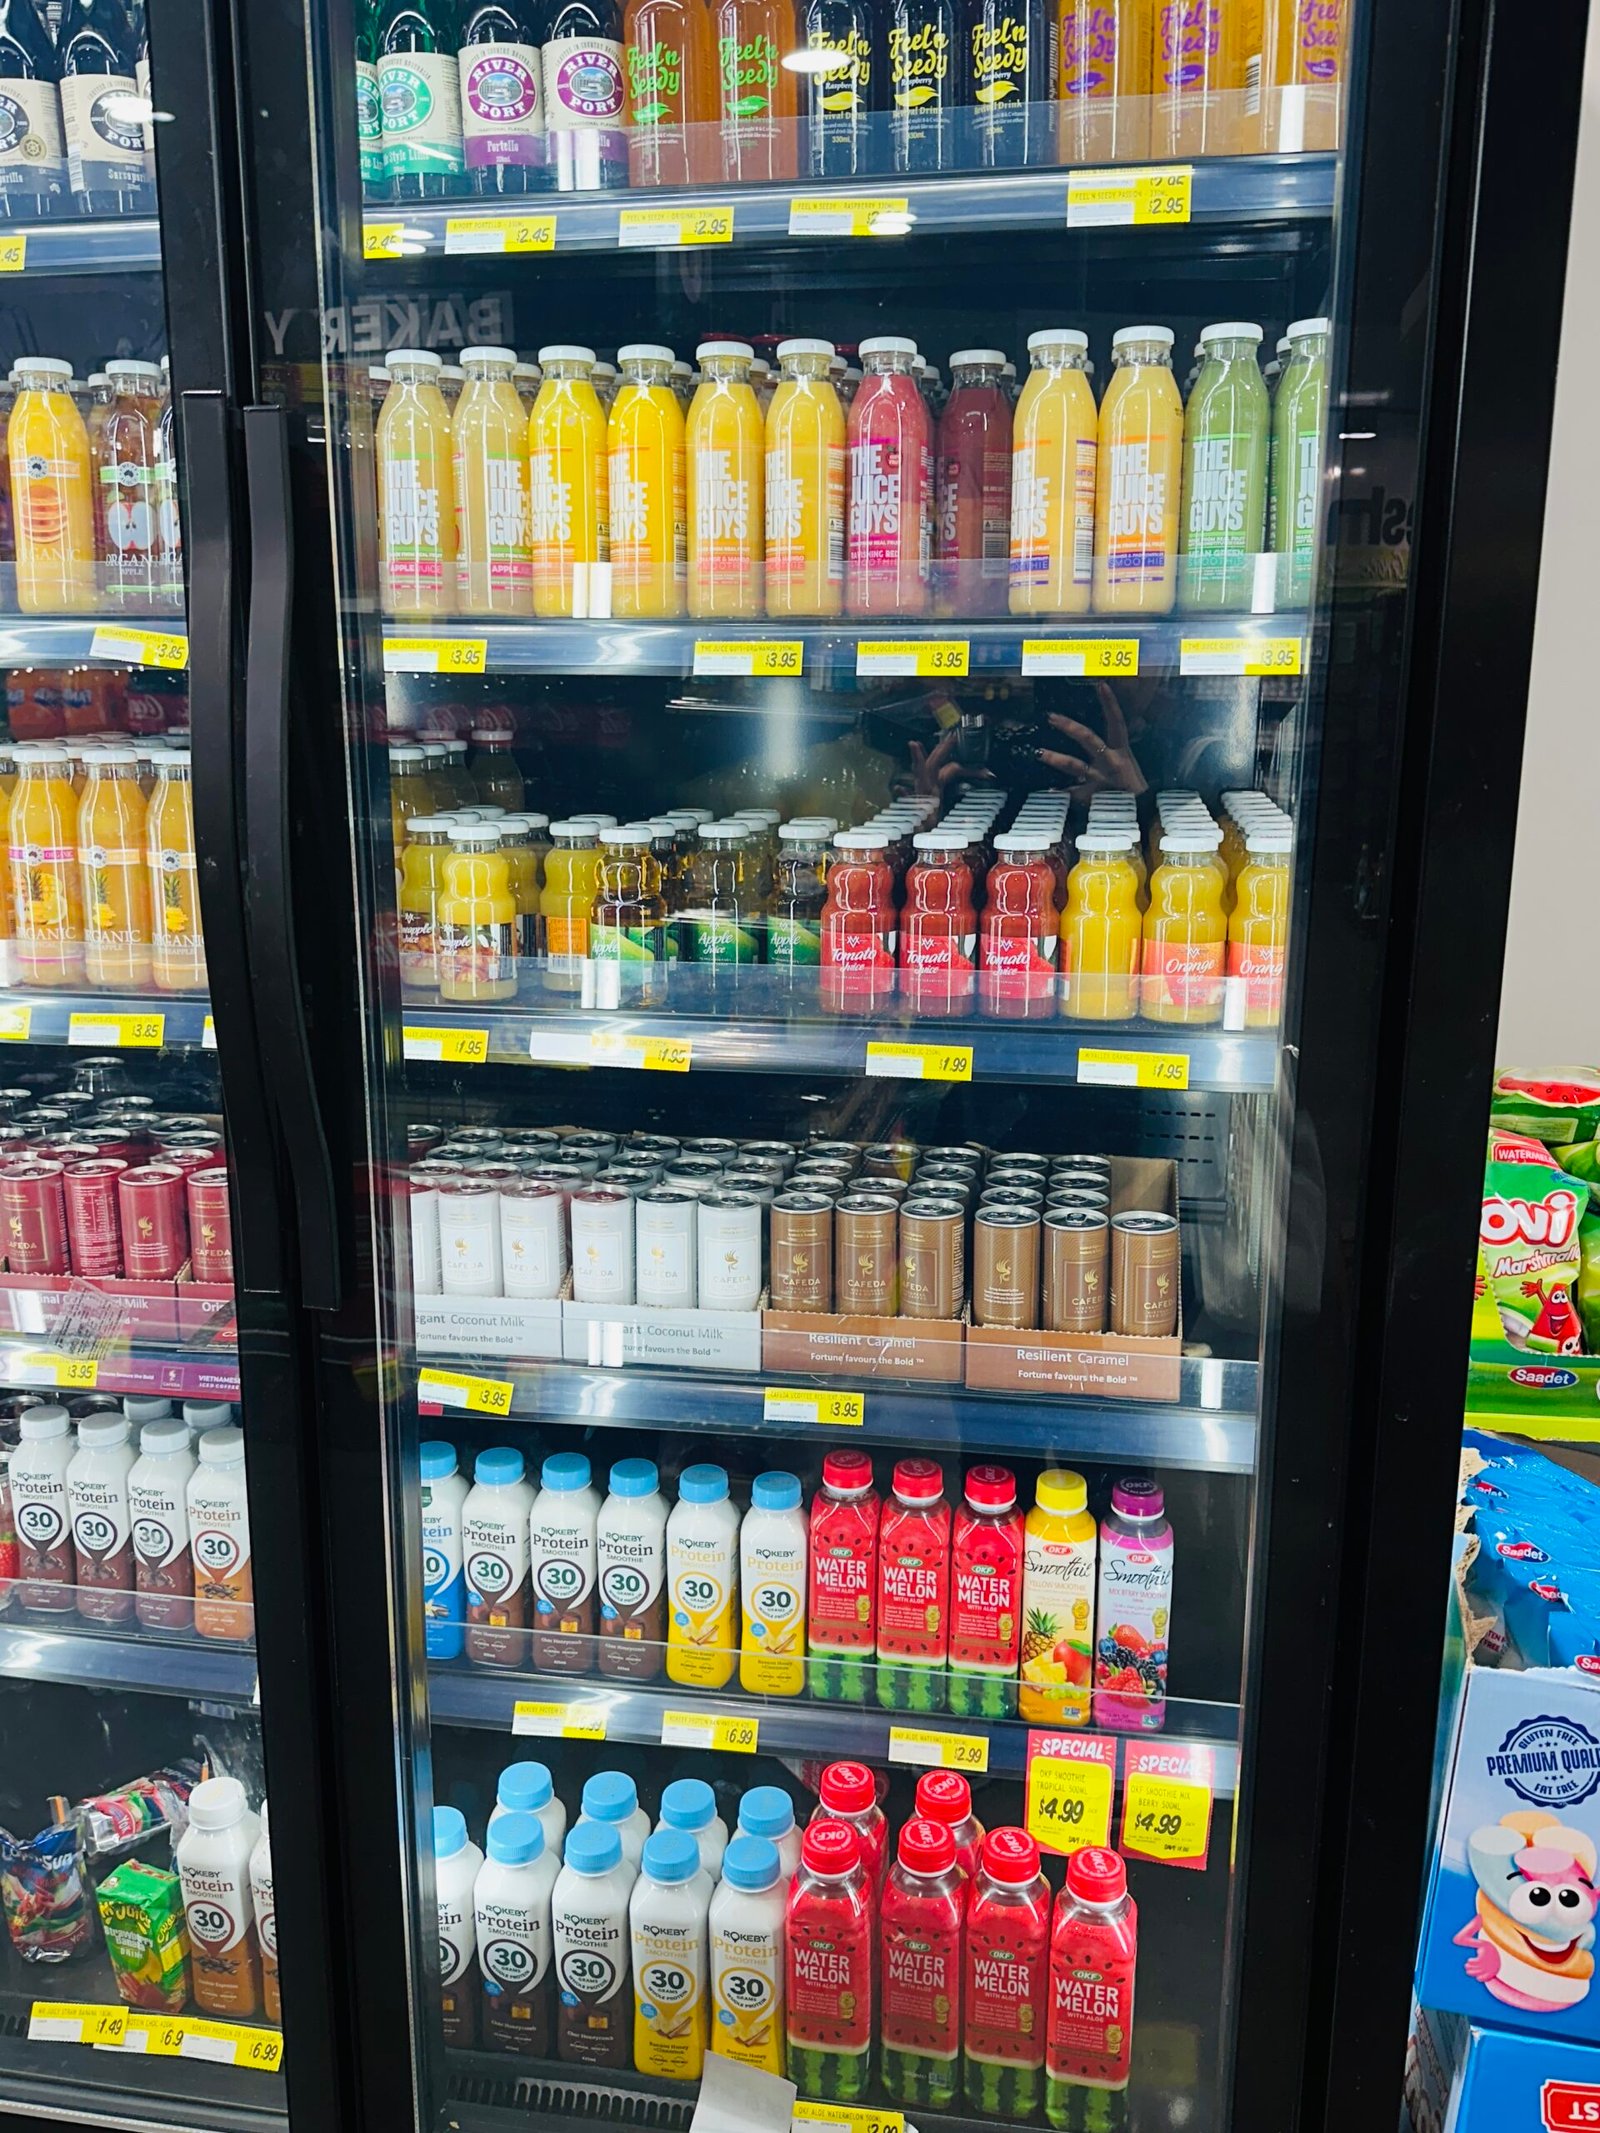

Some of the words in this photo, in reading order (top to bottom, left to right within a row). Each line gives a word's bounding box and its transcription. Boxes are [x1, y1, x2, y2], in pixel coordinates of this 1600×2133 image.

[889, 23, 949, 59] Feel'n
[972, 17, 1028, 49] Feel'n
[472, 58, 527, 81] RIVER
[564, 52, 618, 77] RIVER
[892, 52, 949, 83] Seedy
[973, 44, 1028, 79] Seedy
[630, 66, 680, 99] Seedy
[723, 60, 778, 91] Seedy
[981, 71, 1012, 82] Raspberry
[478, 101, 526, 119] PORT
[569, 96, 617, 116] PORT
[487, 139, 519, 153] Portello
[1148, 198, 1184, 214] $2.95
[694, 219, 728, 235] $2.95
[850, 443, 883, 476] THE
[1193, 440, 1230, 471] THE
[850, 474, 899, 505] JUICE
[1191, 469, 1248, 502] JUICE
[850, 503, 899, 536] GUYS
[1190, 500, 1244, 533] GUYS
[389, 517, 438, 545] GUYS
[766, 652, 797, 668] $3.95
[931, 653, 963, 668] $3.95
[1100, 651, 1132, 667] $3.95
[698, 931, 734, 946] Apple
[770, 932, 800, 946] Apple
[832, 947, 876, 963] Tomato
[907, 949, 951, 965] Tomato
[986, 951, 1030, 966] Tomato
[1166, 958, 1216, 975] Orange
[1240, 959, 1284, 976] Orang
[455, 1040, 482, 1055] $1.95
[939, 1057, 967, 1072] $1.99
[1153, 1063, 1184, 1080] $1.95
[783, 1278, 821, 1286] CAFEDA
[848, 1279, 886, 1288] CAFEDA
[124, 1298, 149, 1310] Milk
[450, 1314, 497, 1326] Coconut
[500, 1316, 525, 1327] Milk
[416, 1332, 447, 1341] Fortune
[448, 1333, 478, 1343] favours
[480, 1335, 493, 1343] the
[495, 1335, 513, 1344] Bold
[647, 1325, 694, 1338] Coconut
[698, 1328, 723, 1340] Milk
[809, 1333, 861, 1345] Resilient
[867, 1337, 915, 1349] Caramel
[810, 1352, 843, 1362] Fortune
[845, 1354, 876, 1364] favours
[879, 1356, 893, 1365] the
[895, 1357, 914, 1366] Bold
[1017, 1349, 1072, 1363] Resilient
[1078, 1352, 1129, 1366] Caramel
[1018, 1369, 1053, 1380] Fortune
[1054, 1372, 1088, 1382] favours
[1089, 1374, 1104, 1383] the
[1107, 1375, 1127, 1384] Bold
[1515, 1367, 1570, 1385] Saadet
[480, 1389, 507, 1407] $3.95
[830, 1402, 858, 1418] $3.95
[11, 1479, 64, 1494] Protein
[26, 1511, 53, 1528] 30
[189, 1507, 242, 1522] Protein
[82, 1520, 108, 1537] 30
[469, 1520, 506, 1531] ROKEBY
[203, 1539, 231, 1556] 30
[533, 1534, 589, 1551] Protein
[599, 1538, 653, 1557] Protein
[832, 1548, 851, 1557] OKF
[1501, 1543, 1544, 1561] Saadet
[476, 1560, 504, 1579] 30
[816, 1557, 866, 1574] WATER
[901, 1558, 919, 1566] OKF
[547, 1568, 576, 1586] 30
[612, 1573, 640, 1592] 30
[816, 1572, 867, 1589] MELON
[884, 1566, 937, 1586] WATER
[957, 1574, 1010, 1593] WATER
[884, 1581, 937, 1600] MELON
[957, 1590, 1010, 1607] MELON
[725, 1728, 752, 1744] $6.99
[1517, 1729, 1555, 1750] GLUTEN
[1556, 1729, 1581, 1747] FREE
[954, 1746, 981, 1763] $2.99
[1040, 1738, 1105, 1760] SPECIAL
[1486, 1751, 1558, 1778] PREMIUM
[1560, 1745, 1600, 1772] QUALI
[1036, 1781, 1066, 1793] TROPICAL
[1069, 1785, 1088, 1795] 500ML
[1131, 1785, 1144, 1793] OKF
[1146, 1786, 1177, 1798] SMOOTHIE
[1180, 1789, 1191, 1799] MIX
[1534, 1781, 1555, 1797] FAT
[1556, 1779, 1580, 1796] FREE
[1039, 1795, 1084, 1824] $4.99
[1138, 1798, 1159, 1808] BERRY
[1161, 1800, 1181, 1811] 500ML
[1135, 1812, 1182, 1835] $4.99
[183, 1867, 221, 1878] ROKEBY
[195, 1909, 224, 1928] 30
[486, 1904, 529, 1917] ROKEBY
[477, 1908, 540, 1932] Protein
[564, 1913, 609, 1926] ROKEBY
[488, 1927, 529, 1939] SMOOTHIE
[555, 1918, 619, 1941] Protein
[494, 1947, 527, 1969] 30
[795, 1948, 850, 1970] WATER
[571, 1958, 604, 1980] 30
[795, 1962, 850, 1985] MELON
[974, 1959, 1029, 1981] WATER
[1076, 1972, 1098, 1981] OKF
[651, 1968, 685, 1990] 30
[974, 1974, 1029, 1997] MELON
[1055, 1978, 1118, 2001] WATER
[1056, 1994, 1118, 2018] MELON
[1067, 2012, 1084, 2021] WITH
[1085, 2013, 1103, 2023] ALOE
[96, 2019, 121, 2035] $1.49
[161, 2030, 182, 2047] $6.9
[250, 2042, 278, 2062] $6.99
